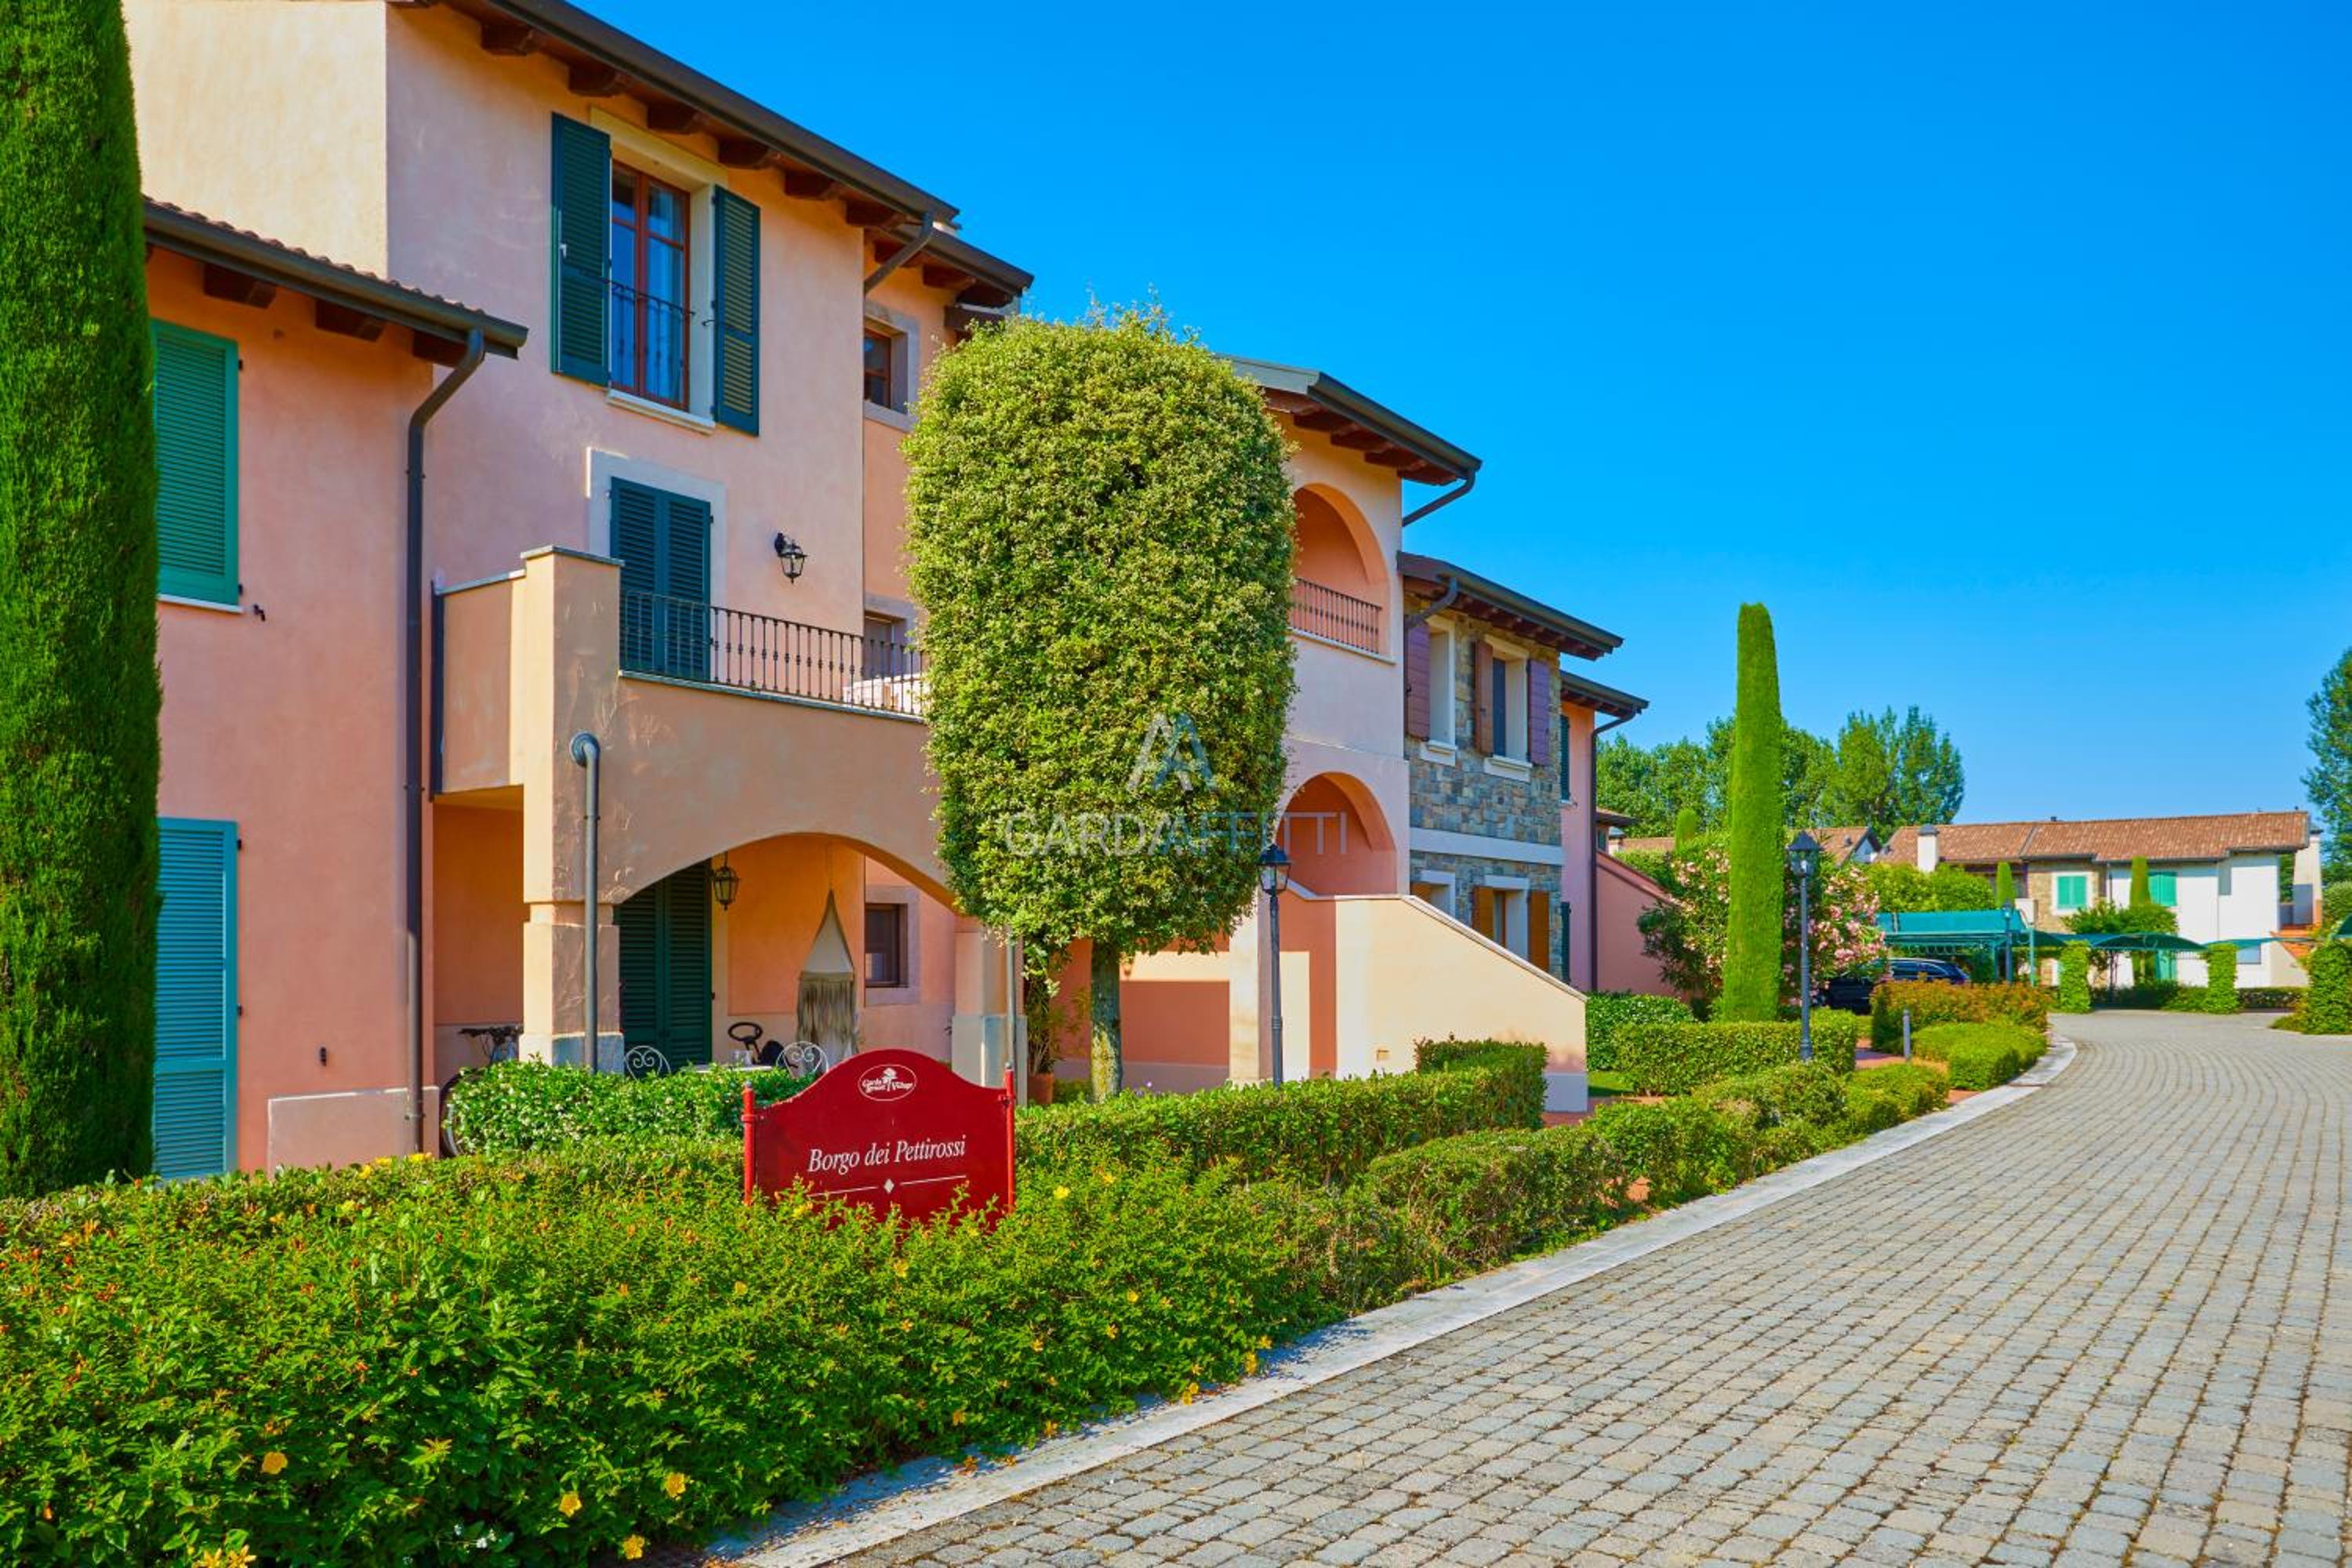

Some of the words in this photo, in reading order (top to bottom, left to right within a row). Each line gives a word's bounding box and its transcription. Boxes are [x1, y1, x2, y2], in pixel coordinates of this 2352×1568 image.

[807, 1148, 860, 1175] Borgo
[864, 1142, 891, 1167] dei
[894, 1134, 967, 1163] Pettirossi
